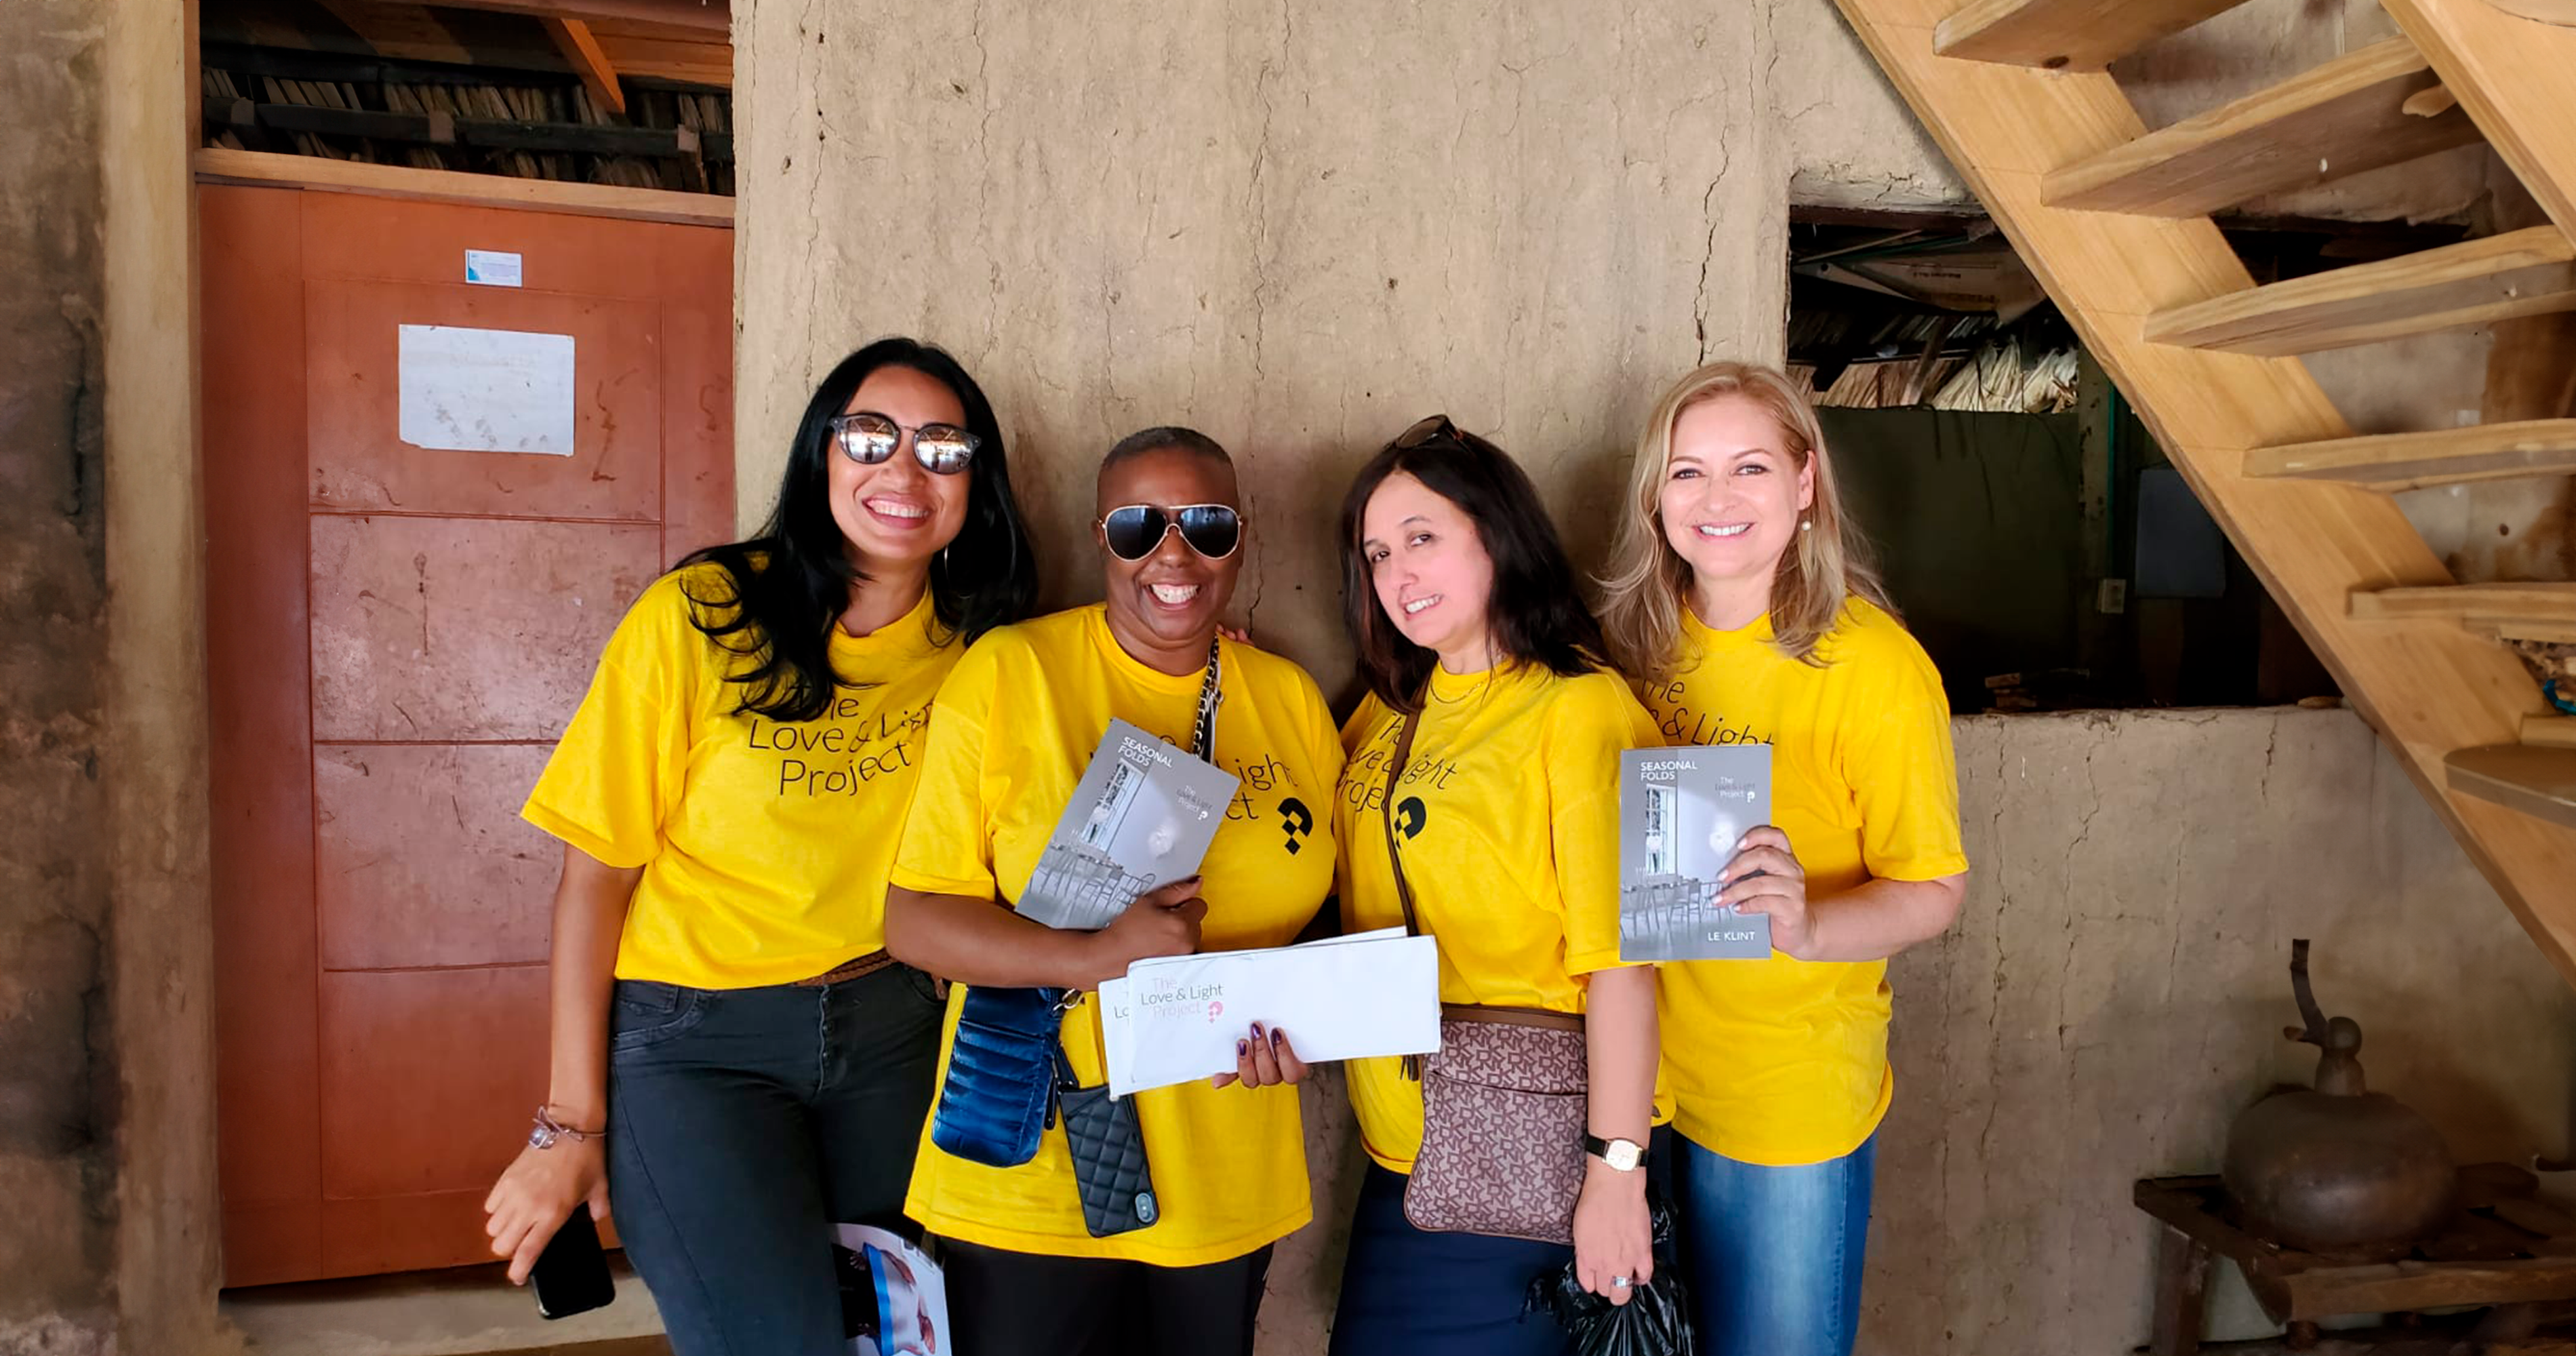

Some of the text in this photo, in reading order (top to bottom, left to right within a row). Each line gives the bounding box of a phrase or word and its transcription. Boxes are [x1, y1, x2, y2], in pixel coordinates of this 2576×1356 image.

[1662, 708, 1688, 740] &
[749, 719, 844, 753] Love
[1119, 745, 1150, 767] FOLDS
[1123, 736, 1173, 768] SEASONAL
[780, 740, 912, 796] Project
[1215, 754, 1298, 791] ight
[1402, 754, 1457, 790] ight
[1641, 761, 1697, 772] SEASONAL
[1641, 771, 1675, 781] FOLDS
[1708, 931, 1755, 941] LE KLINT
[1141, 992, 1173, 1005] Love
[1175, 988, 1186, 1001] &
[1190, 984, 1224, 1000] Light
[1152, 977, 1178, 992] The
[1152, 1001, 1202, 1019] Project
